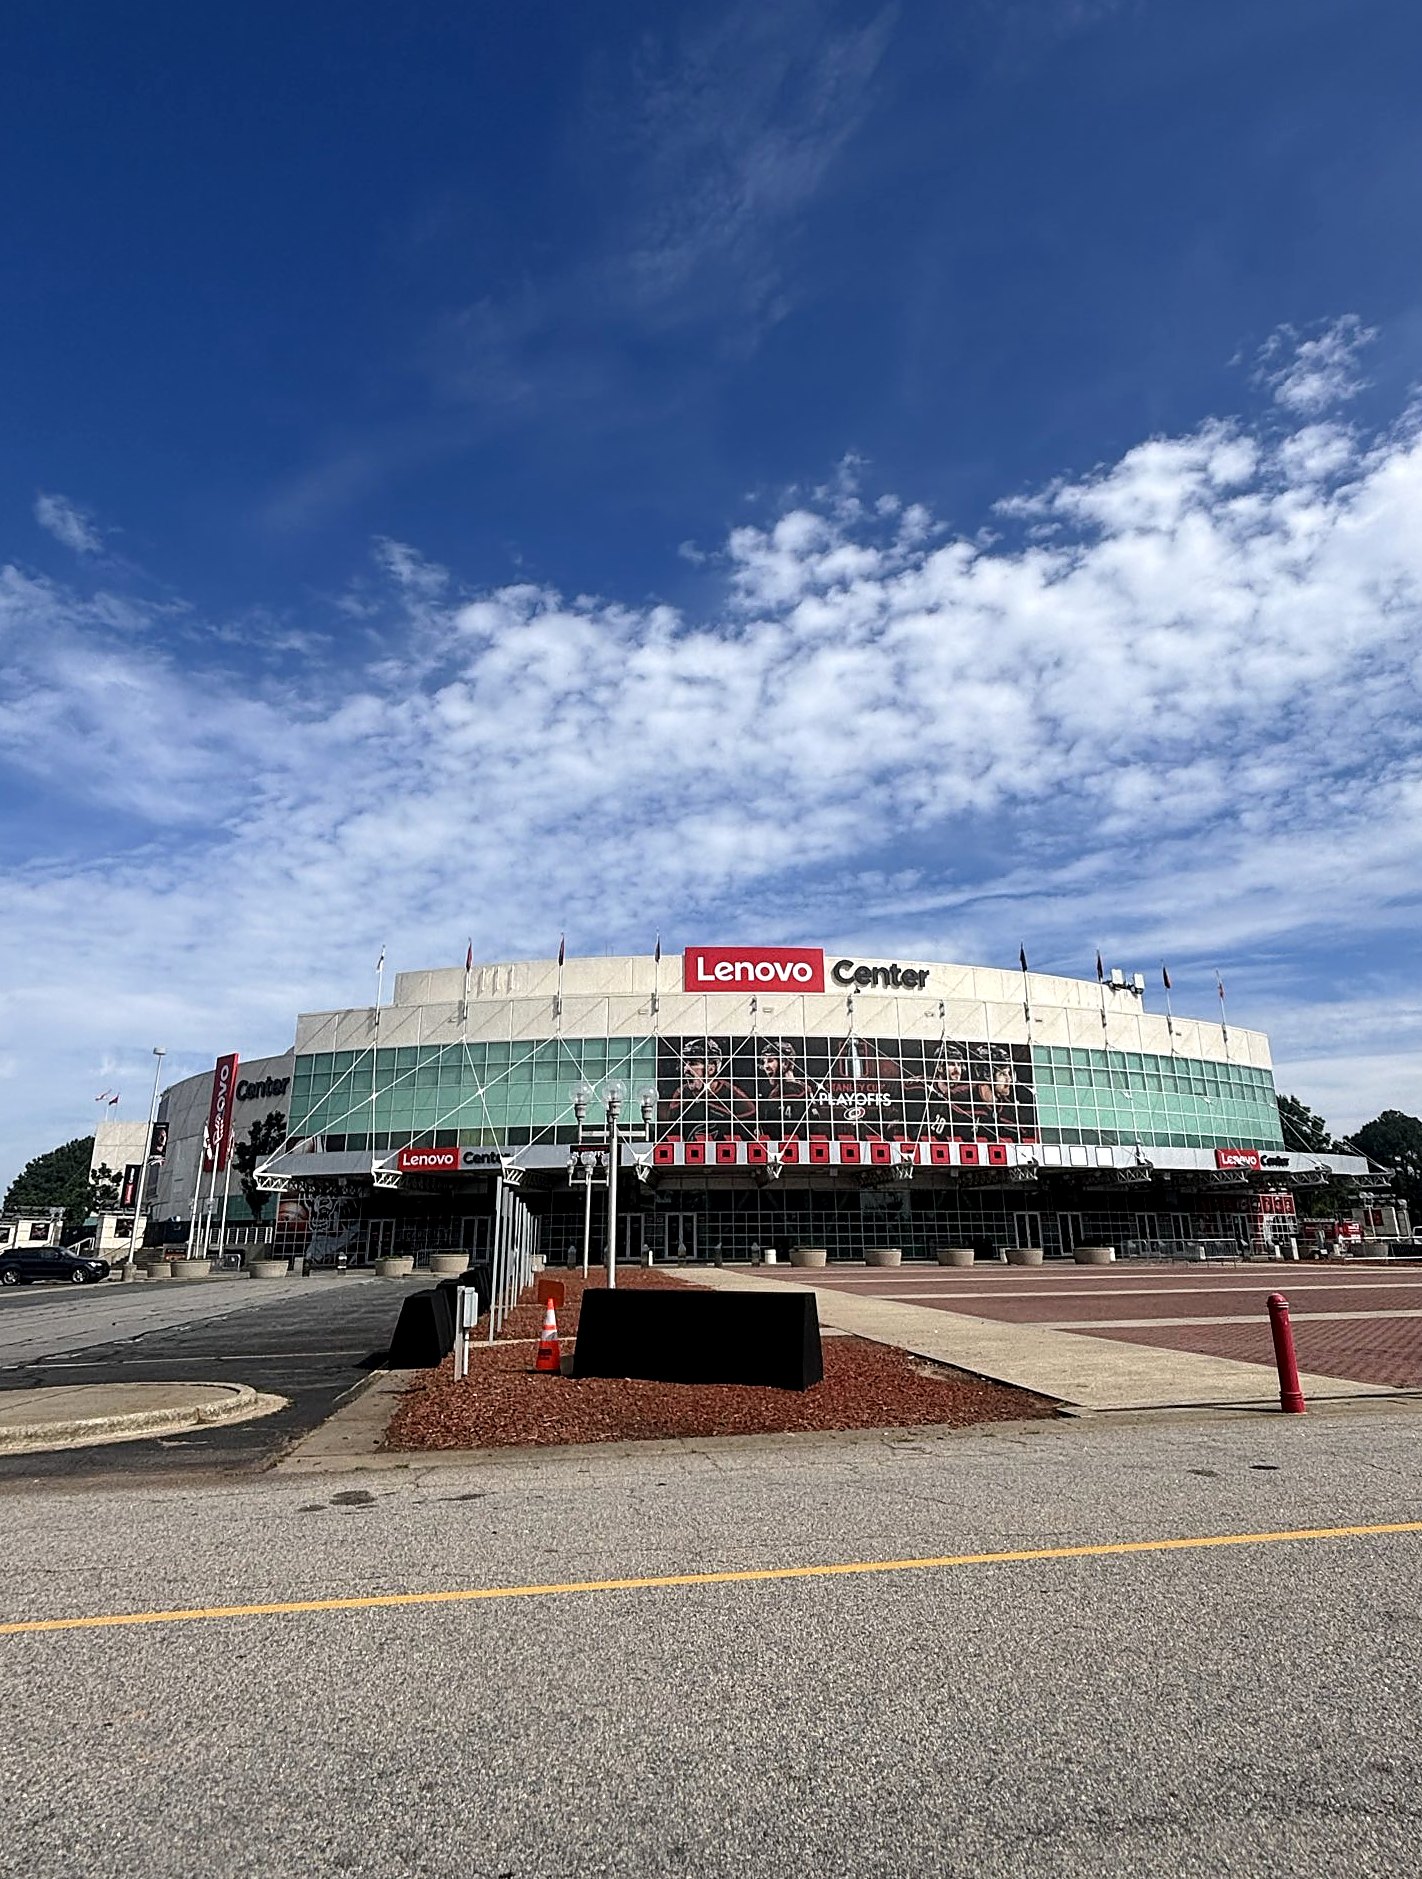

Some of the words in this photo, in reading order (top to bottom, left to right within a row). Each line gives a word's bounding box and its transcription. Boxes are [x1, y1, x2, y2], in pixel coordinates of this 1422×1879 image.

[697, 957, 813, 982] Lenovo
[832, 959, 930, 988] Center
[236, 1076, 290, 1101] Center
[819, 1092, 892, 1107] PLAYOFFS
[931, 1114, 947, 1134] 20
[402, 1153, 455, 1166] Lenovo
